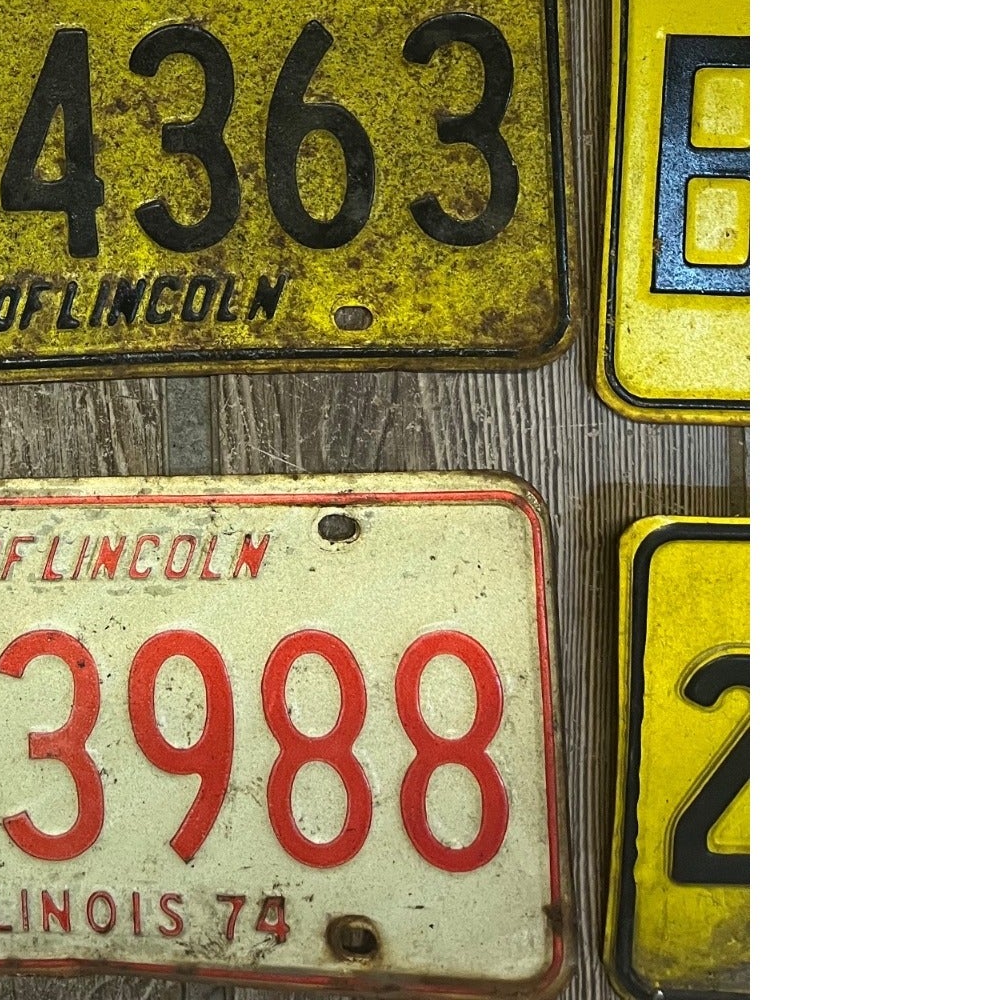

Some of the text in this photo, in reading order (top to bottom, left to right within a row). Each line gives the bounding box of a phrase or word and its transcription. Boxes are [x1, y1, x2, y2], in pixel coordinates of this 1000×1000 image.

[0, 12, 519, 259] 4363
[56, 273, 289, 330] LINCOLN
[42, 534, 271, 581] LINCOLN
[217, 894, 291, 944] 74
